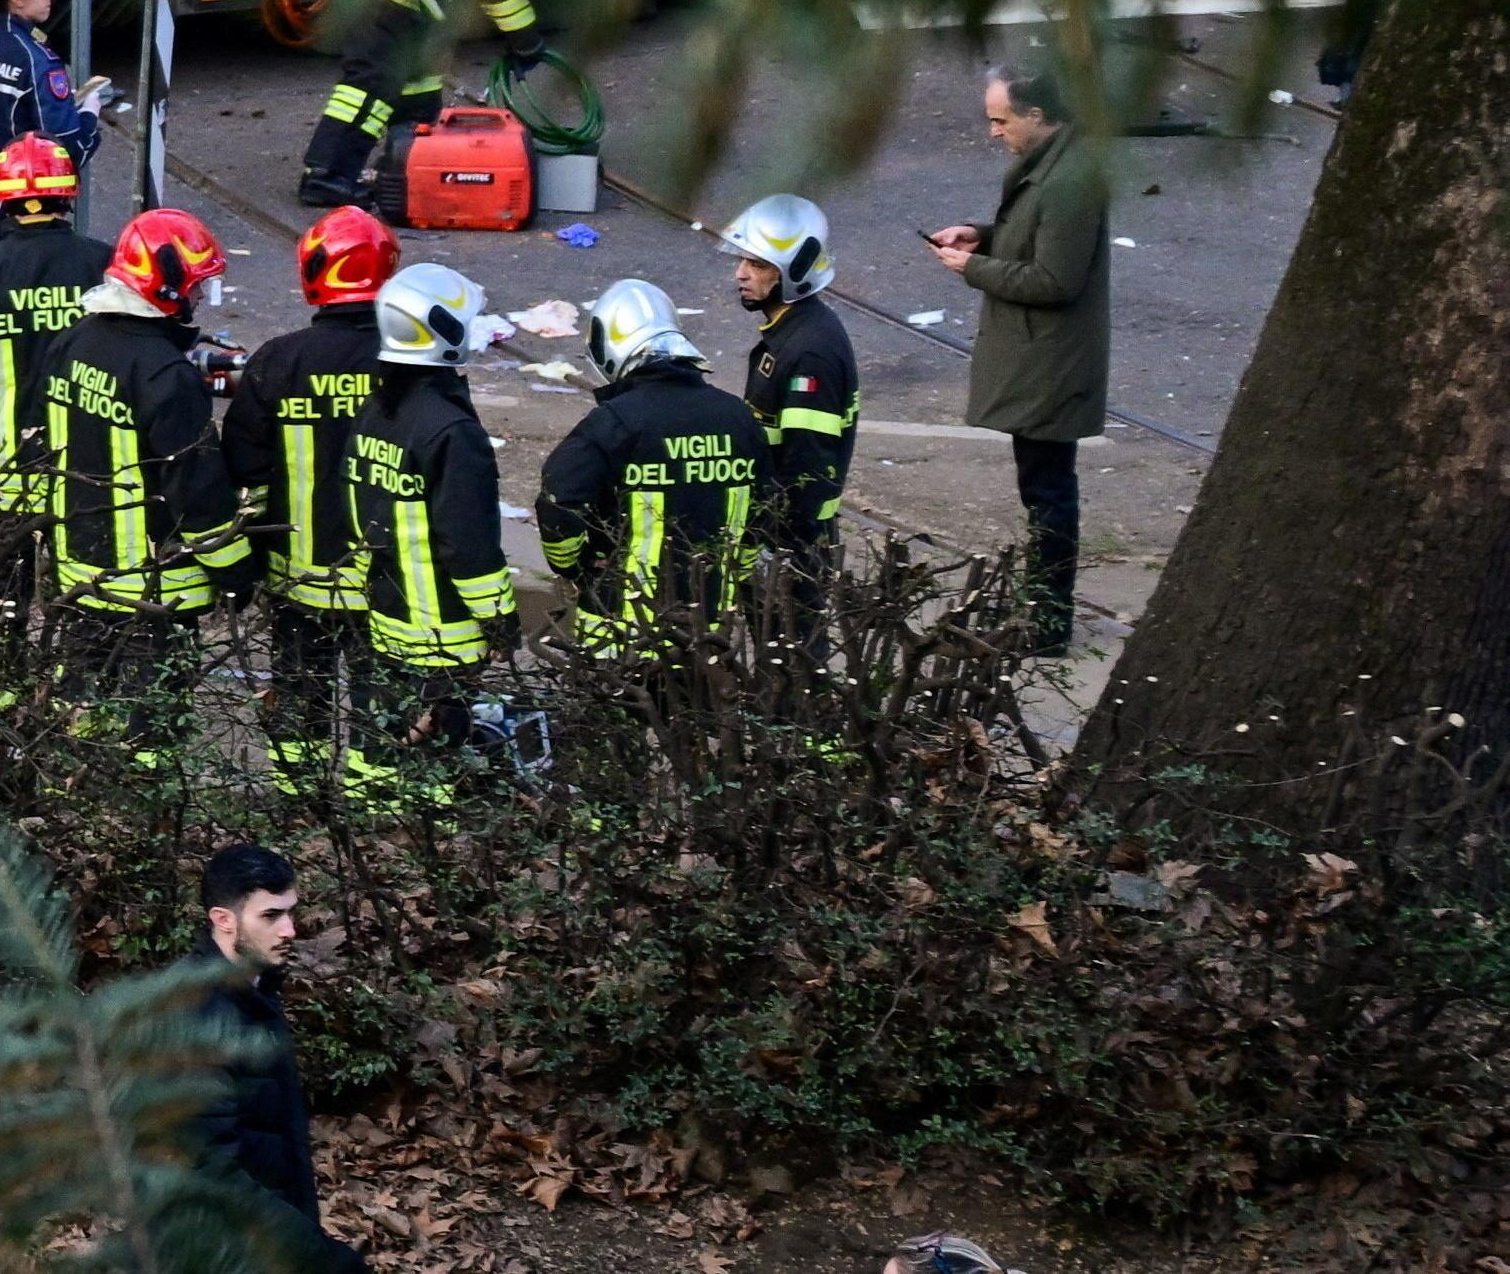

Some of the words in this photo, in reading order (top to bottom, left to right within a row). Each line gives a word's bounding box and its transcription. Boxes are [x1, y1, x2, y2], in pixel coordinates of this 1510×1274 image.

[9, 286, 81, 311] VIGILI
[33, 307, 91, 332] FUO
[71, 360, 117, 397] VIGILI
[310, 373, 383, 397] VIGIL
[665, 434, 731, 460] VIGILI
[625, 463, 675, 485] DEL
